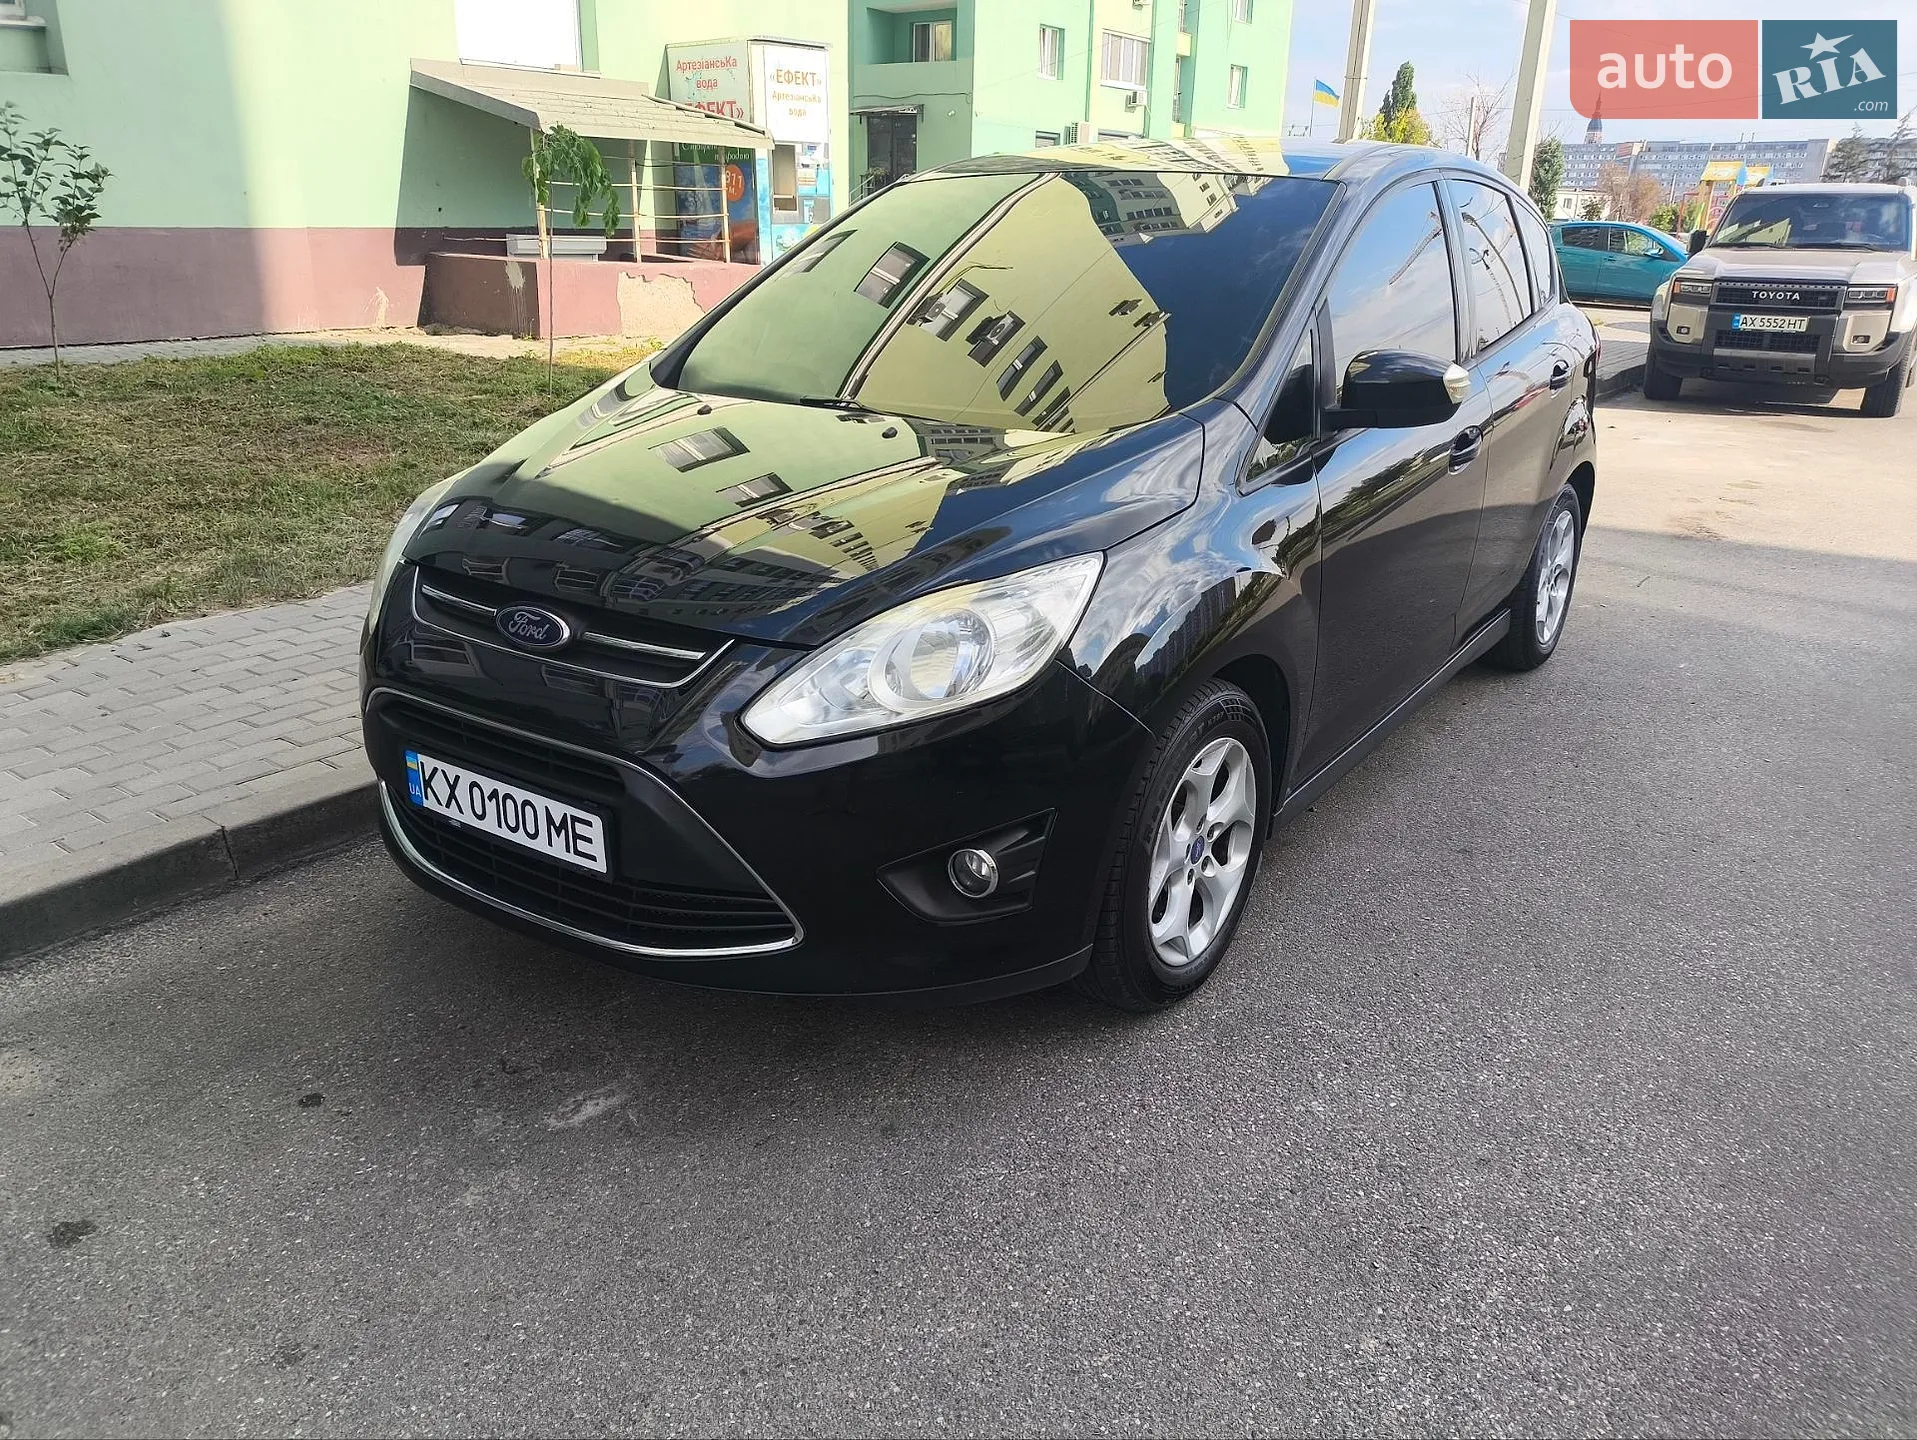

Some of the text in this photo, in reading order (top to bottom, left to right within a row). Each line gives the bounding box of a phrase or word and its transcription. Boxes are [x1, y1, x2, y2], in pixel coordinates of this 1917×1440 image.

[696, 78, 718, 91] вода
[1752, 291, 1800, 300] TOYOTA
[1740, 317, 1757, 327] AX
[1759, 318, 1786, 329] 5552
[1787, 319, 1806, 330] HT
[508, 611, 550, 640] Ford
[408, 782, 422, 796] UA
[419, 760, 598, 863] KX 0100 ME
